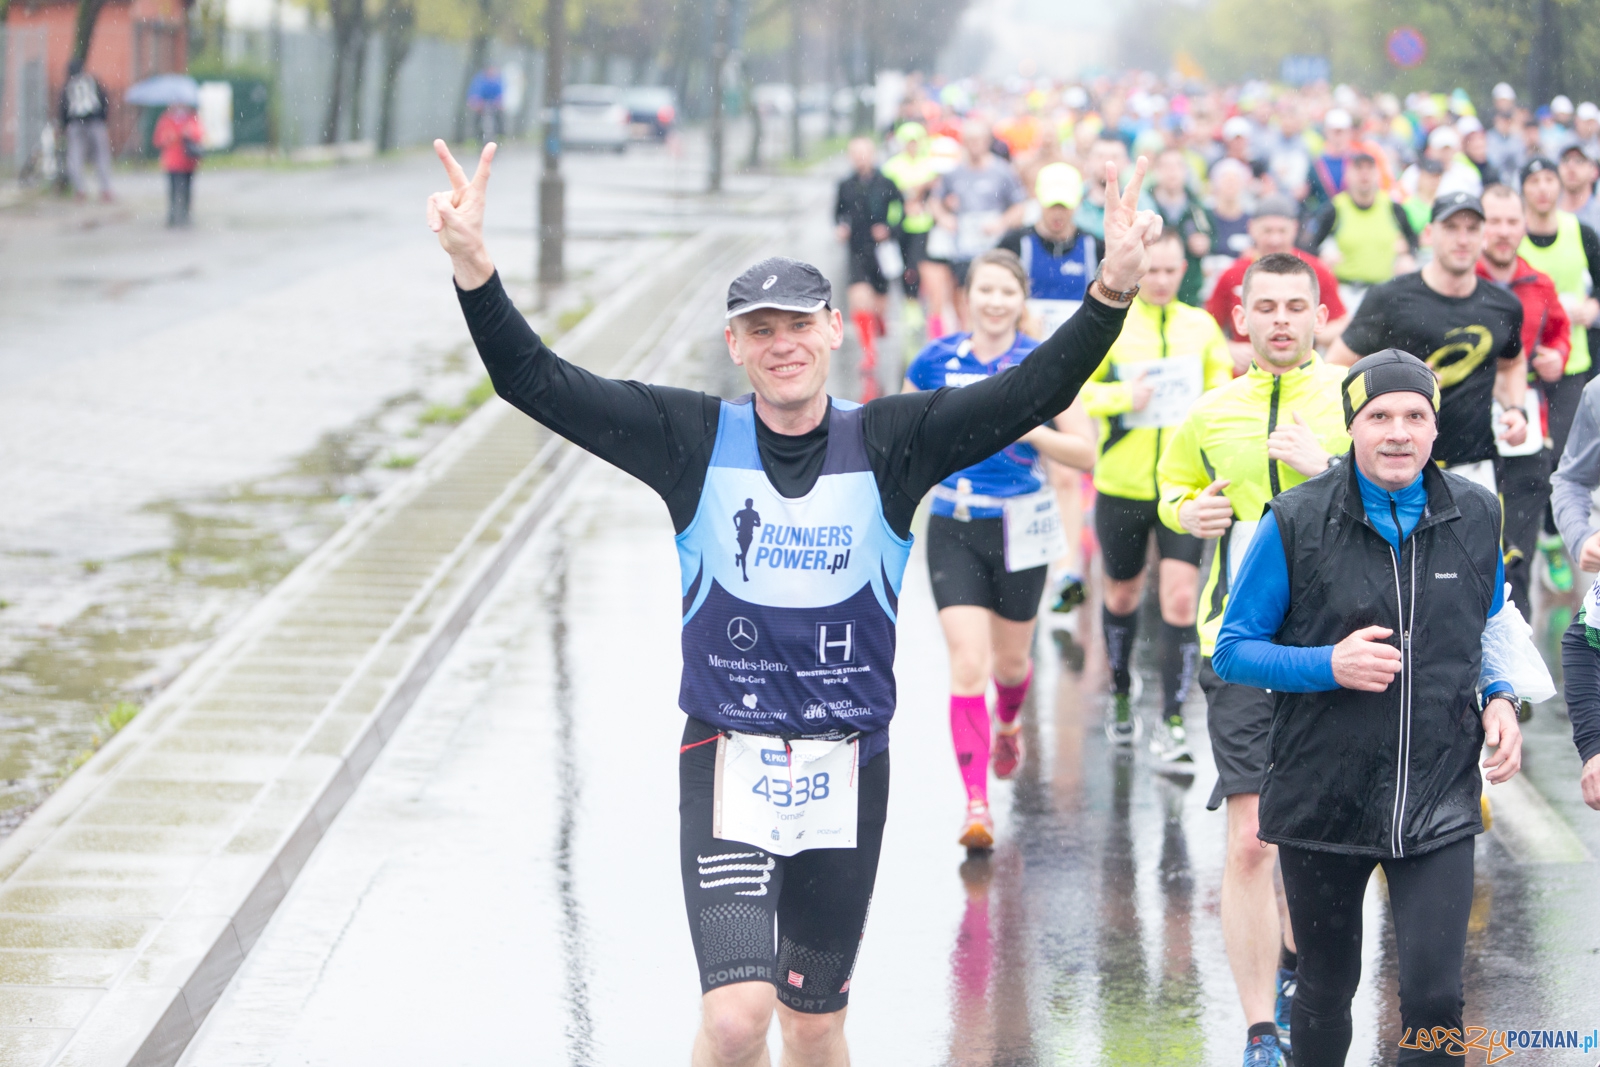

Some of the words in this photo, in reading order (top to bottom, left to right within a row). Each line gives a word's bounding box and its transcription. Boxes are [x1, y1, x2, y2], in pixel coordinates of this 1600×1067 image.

[760, 523, 853, 547] RUNNERS
[754, 546, 851, 575] POWER.pl
[708, 654, 789, 672] Mercedes-Benz
[729, 673, 766, 684] Duda-Cars
[718, 702, 787, 720] Kwiaciarnia
[751, 772, 830, 808] 4338
[775, 810, 806, 821] Tomasz
[707, 965, 772, 985] COMPRE
